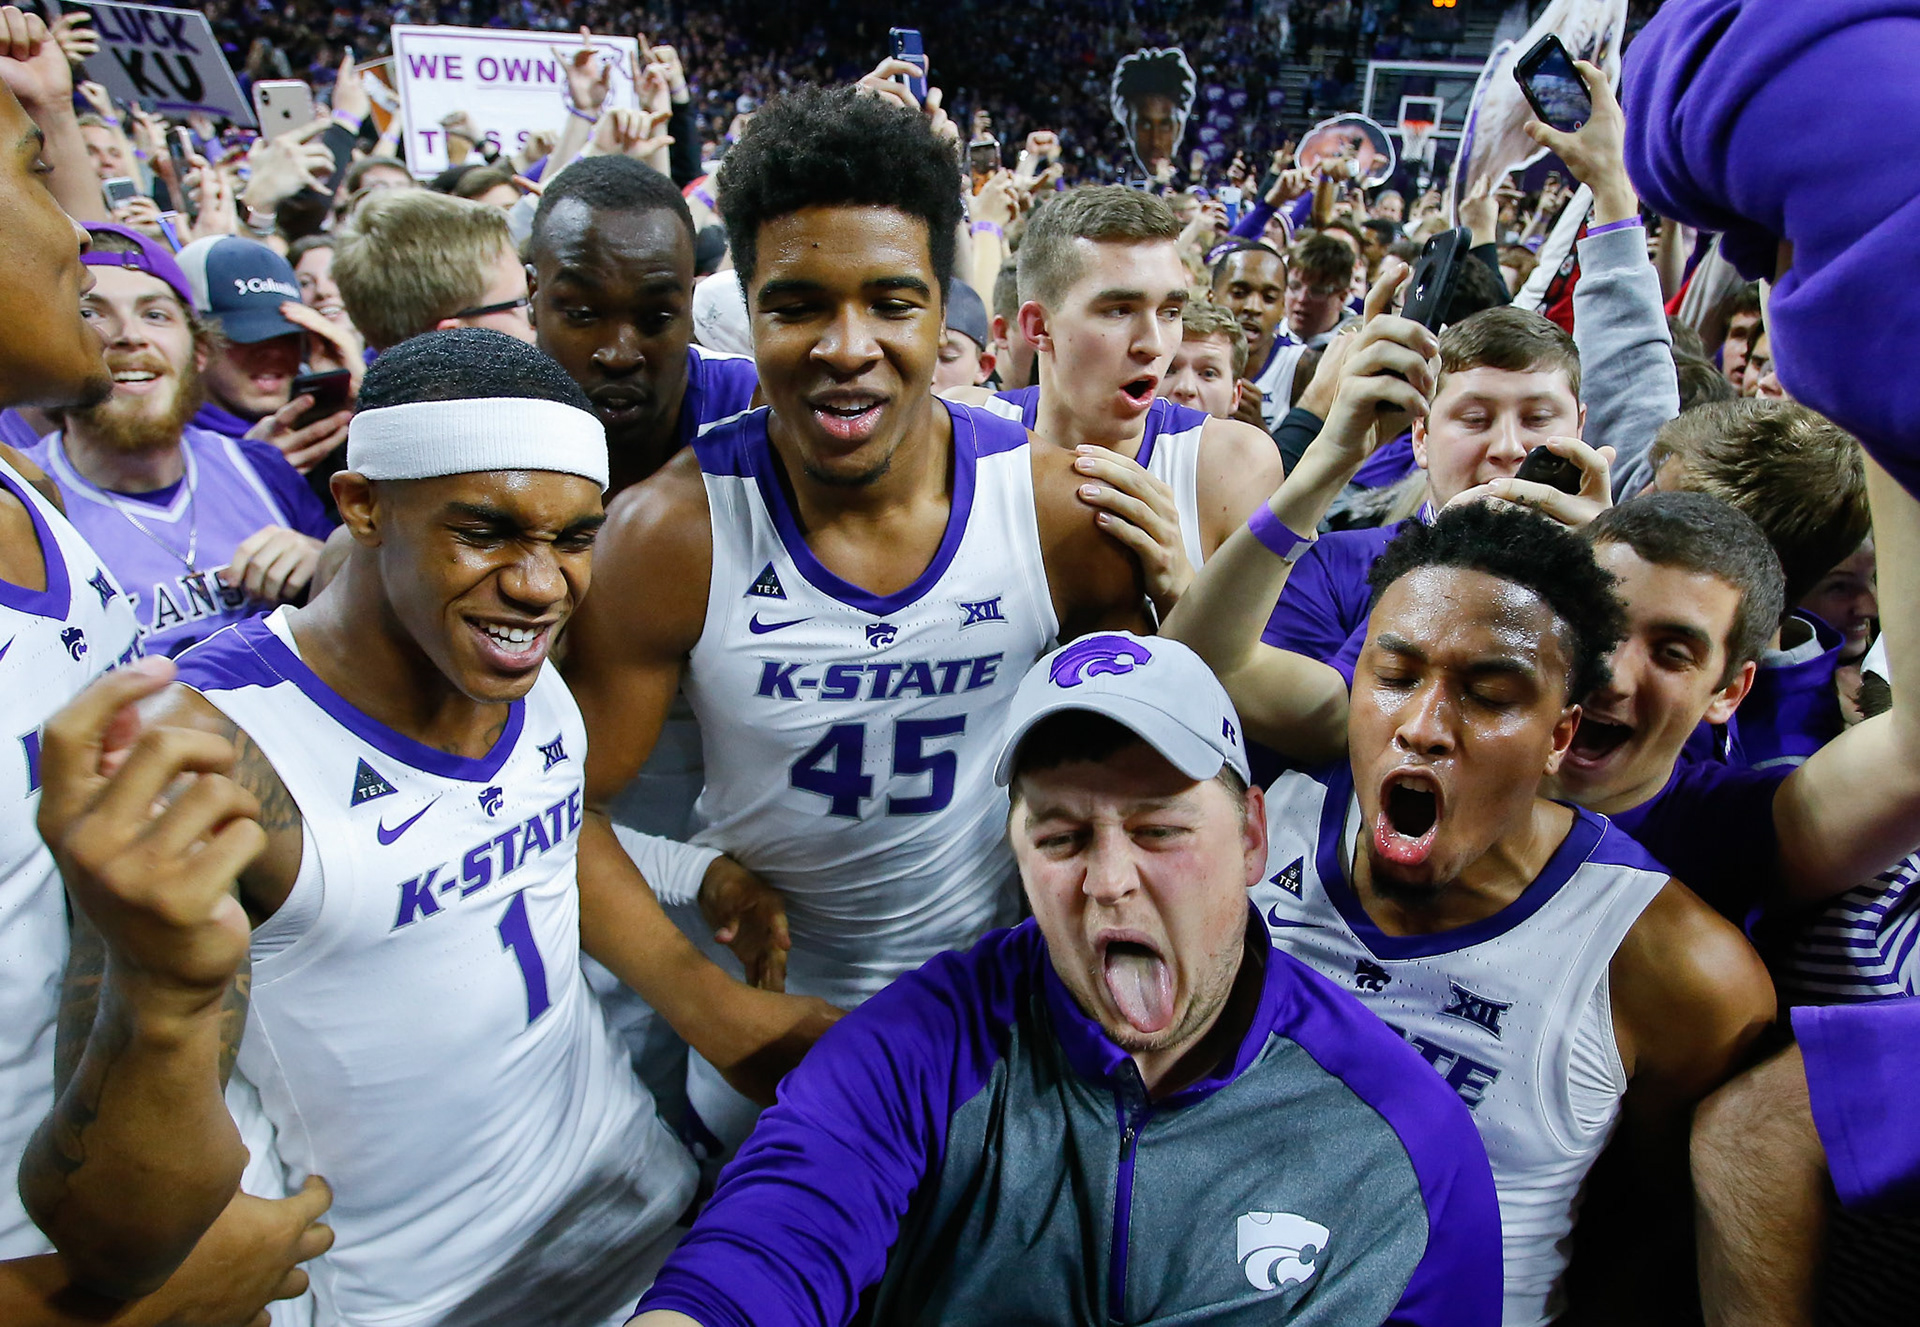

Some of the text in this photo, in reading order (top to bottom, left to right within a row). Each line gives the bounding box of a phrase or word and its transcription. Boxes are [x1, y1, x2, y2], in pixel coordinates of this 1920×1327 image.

[111, 46, 206, 102] KU
[408, 54, 557, 83] WE OWN
[418, 131, 502, 155] TS
[757, 584, 779, 596] TEX
[956, 594, 1009, 631] XII
[753, 652, 1005, 702] K-STATE
[536, 730, 570, 774] XII
[788, 713, 967, 820] 45
[358, 782, 386, 799] TEX
[389, 785, 583, 933] K-STATE
[1279, 874, 1299, 892] TEX
[496, 889, 551, 1026] 1
[1436, 980, 1513, 1042] XII
